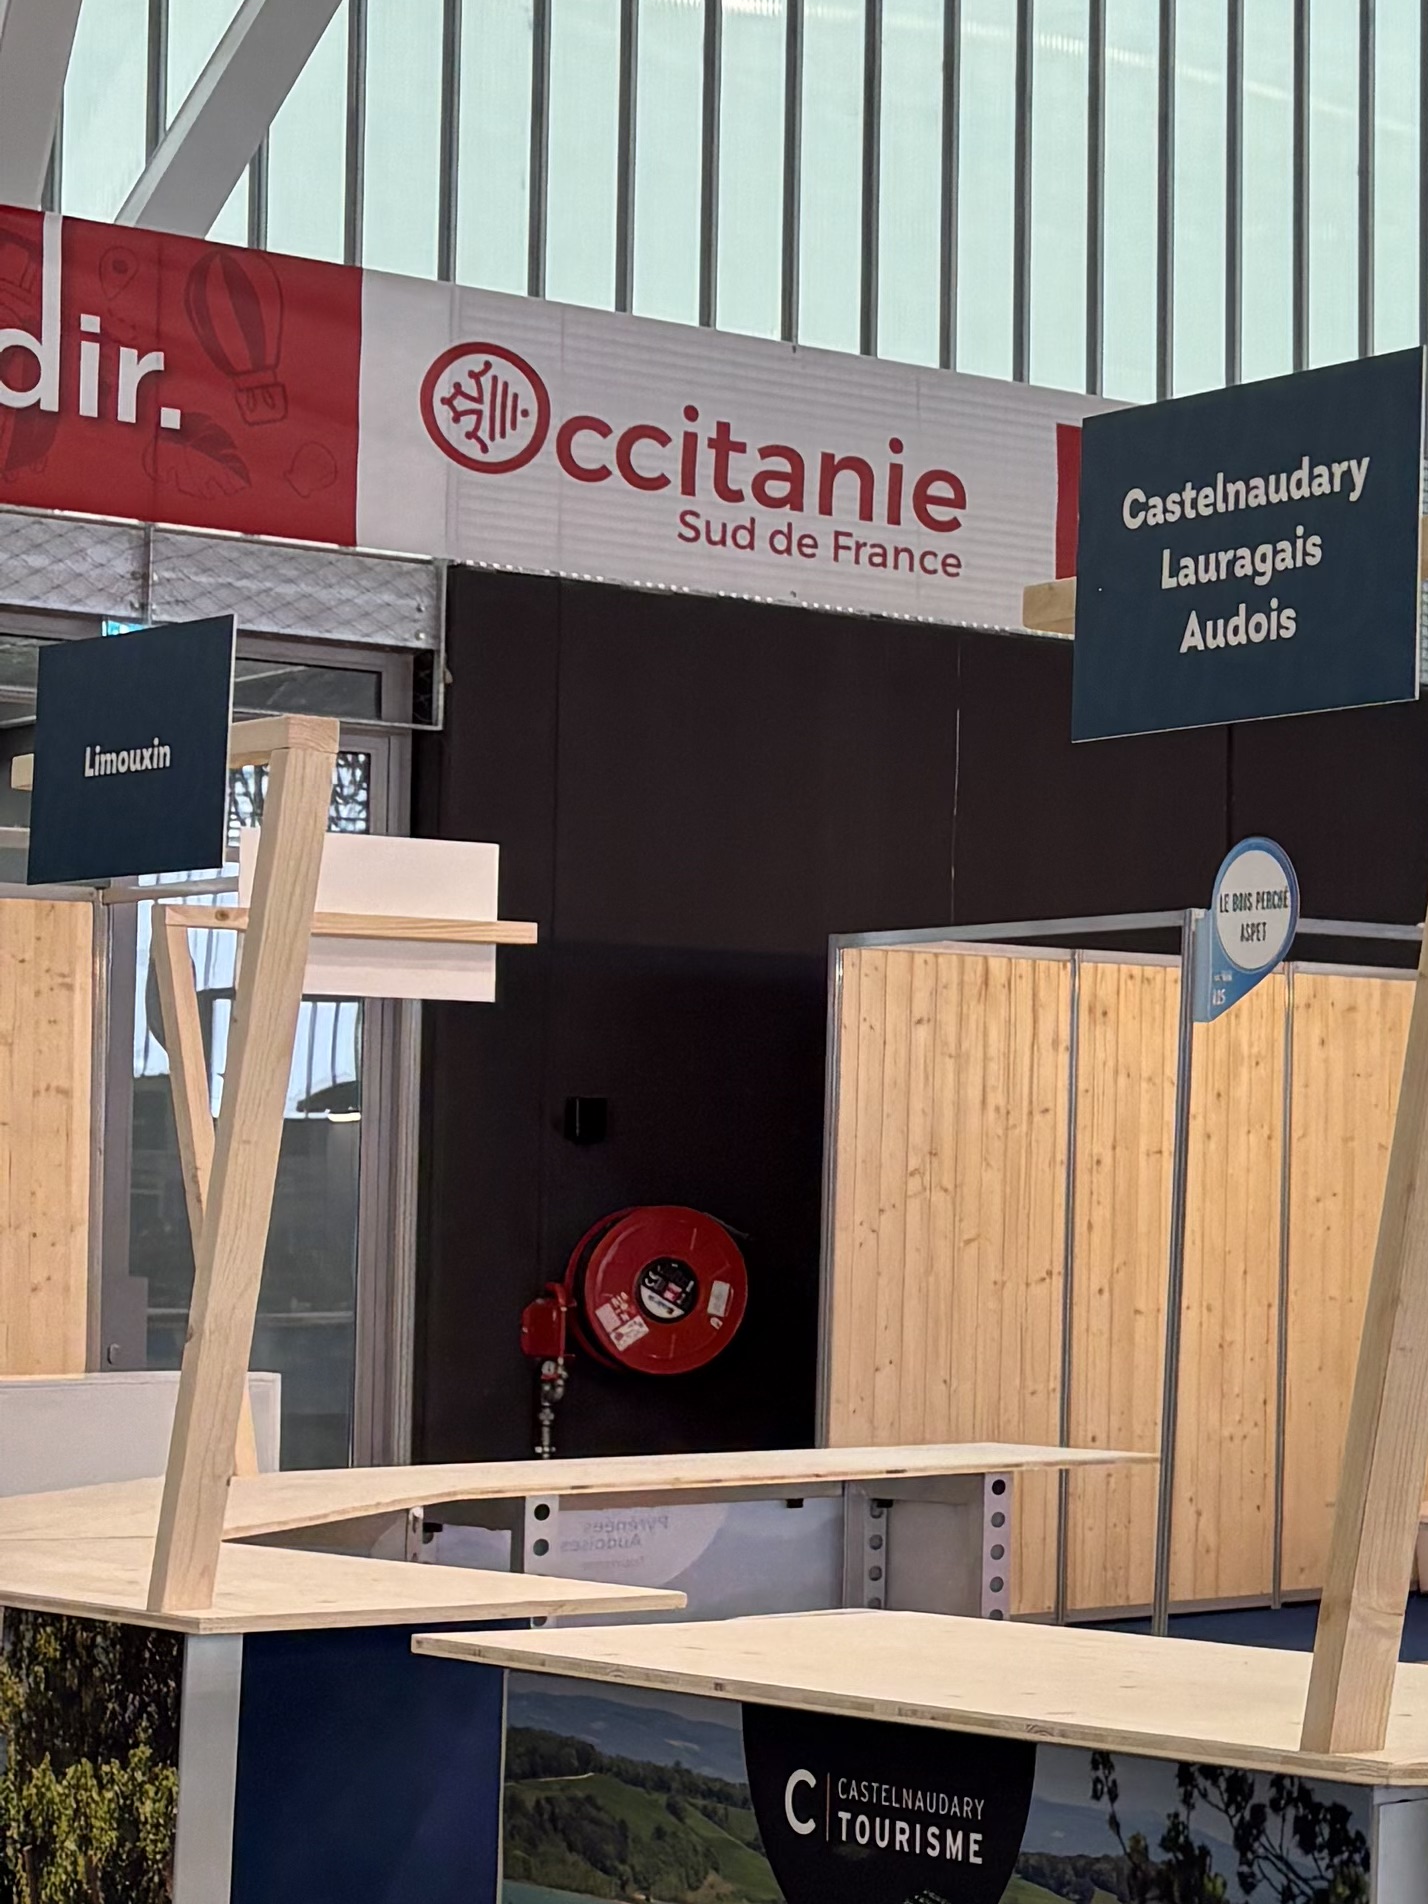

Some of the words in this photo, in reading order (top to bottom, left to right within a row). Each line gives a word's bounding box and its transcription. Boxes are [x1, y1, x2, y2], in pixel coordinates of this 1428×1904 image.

[1122, 456, 1370, 530] Castelnaudary
[677, 508, 757, 553] Sud
[768, 523, 818, 560] de
[832, 530, 962, 579] France
[1161, 526, 1322, 590] Lauragais
[1179, 597, 1297, 654] Audois
[84, 737, 171, 778] Limouxin
[1219, 893, 1229, 913] LE
[1240, 921, 1267, 942] ASPET
[784, 1768, 817, 1836] C
[838, 1777, 985, 1821] CASTELNAUDARY
[838, 1810, 983, 1865] TOURISME
